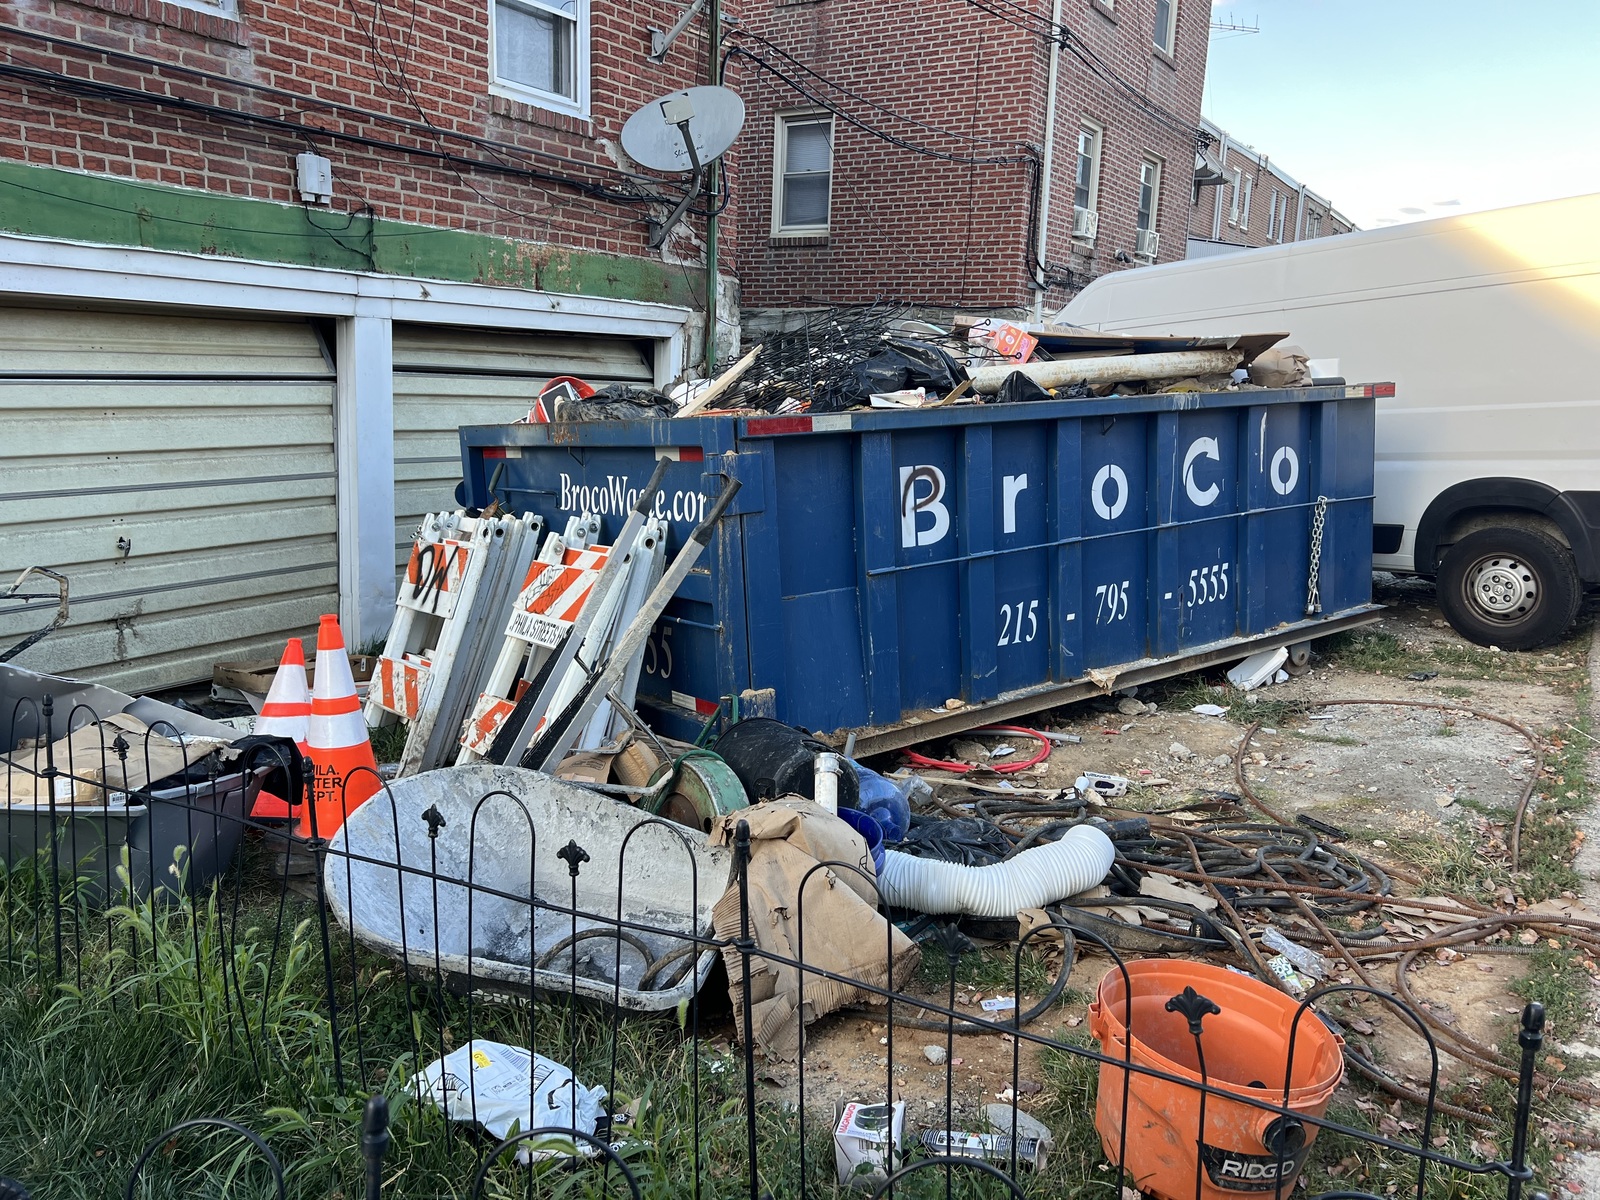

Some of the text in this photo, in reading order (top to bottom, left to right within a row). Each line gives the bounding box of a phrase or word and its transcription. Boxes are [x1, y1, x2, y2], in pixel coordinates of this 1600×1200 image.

[997, 600, 1039, 647] 215
[1094, 580, 1130, 625] 795
[1187, 562, 1229, 608] 5555
[1221, 1159, 1295, 1179] RIDGD
